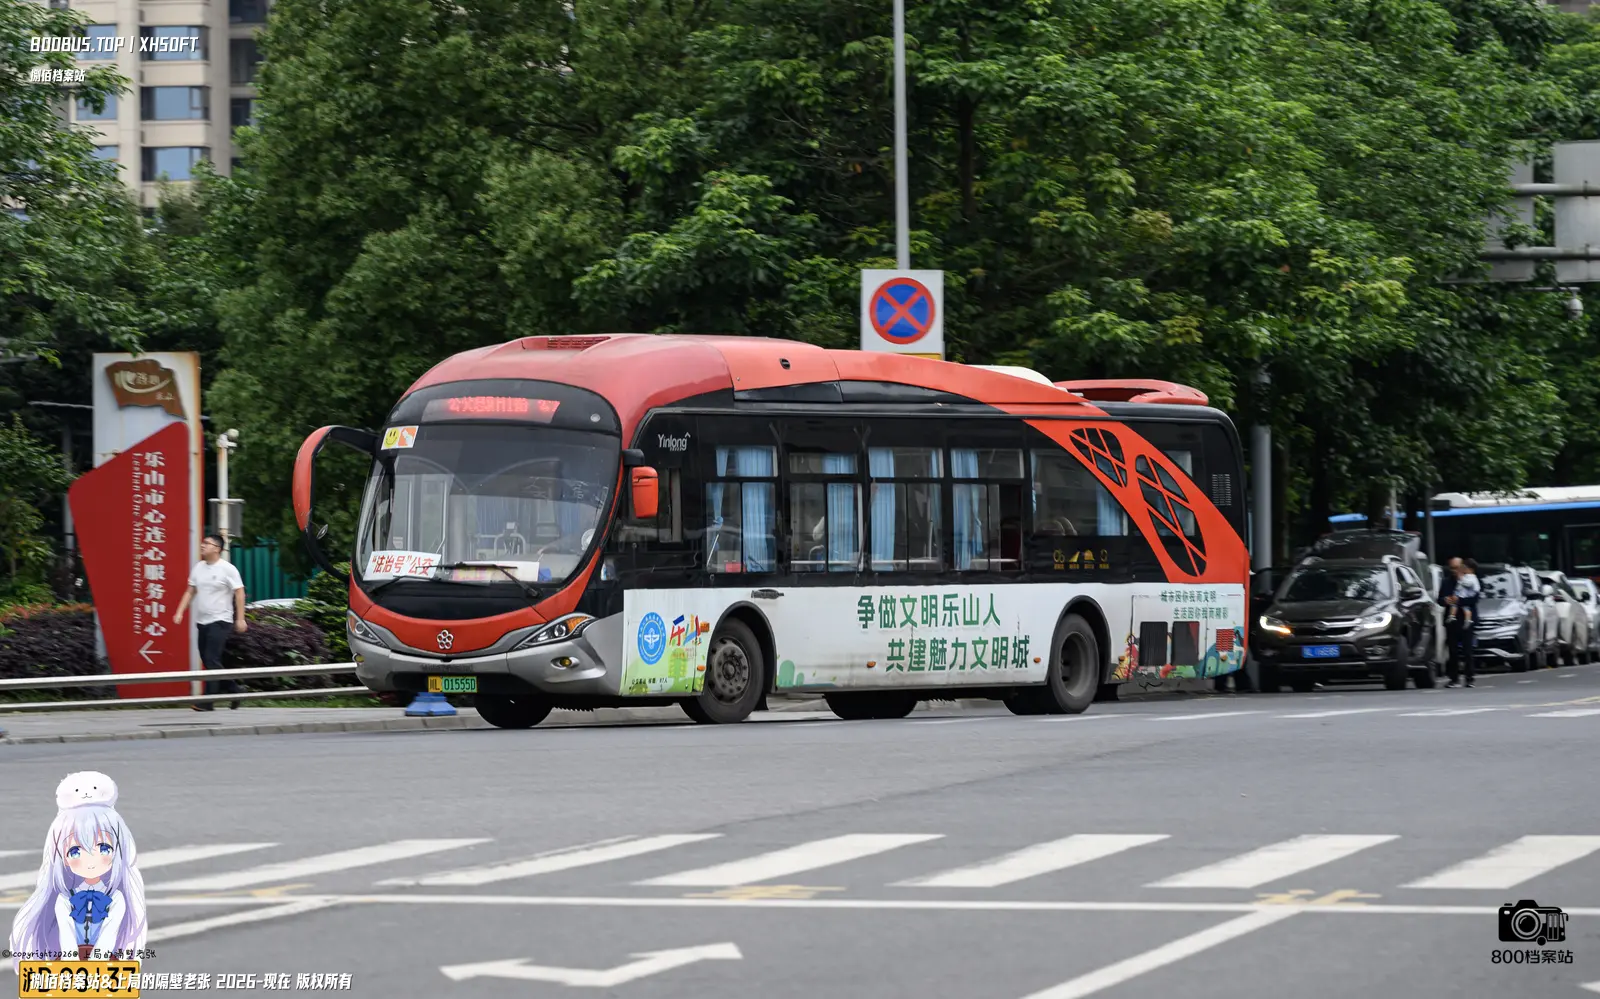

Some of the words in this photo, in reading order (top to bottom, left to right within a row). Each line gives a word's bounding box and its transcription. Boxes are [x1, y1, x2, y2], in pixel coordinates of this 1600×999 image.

[657, 433, 688, 451] Yinlong
[132, 494, 144, 516] One
[132, 521, 144, 549] Mind
[143, 451, 167, 636] 乐山市心连心服务中心
[132, 554, 144, 594] Service
[133, 598, 145, 635] Center
[857, 593, 1001, 629] 争做文明乐山人
[886, 635, 1030, 672] 共建魅力文明城
